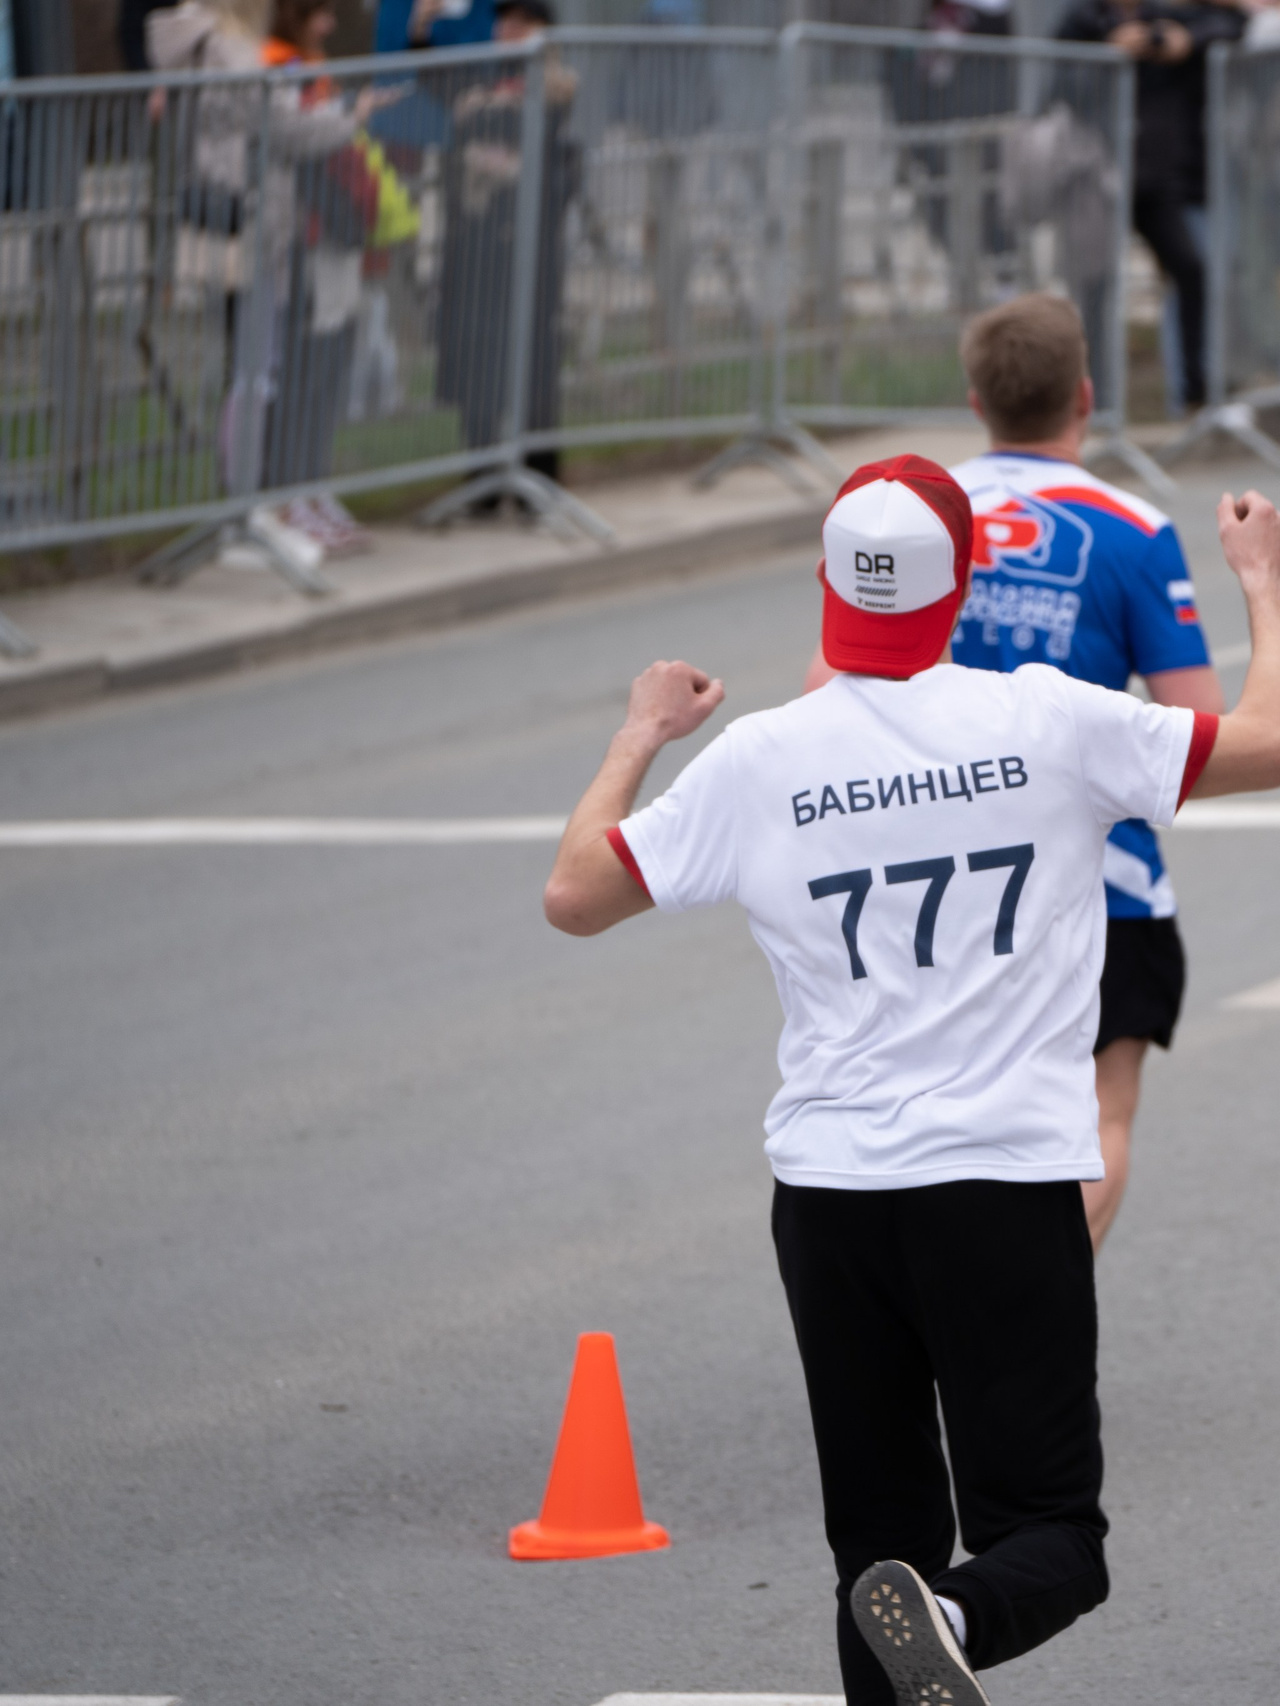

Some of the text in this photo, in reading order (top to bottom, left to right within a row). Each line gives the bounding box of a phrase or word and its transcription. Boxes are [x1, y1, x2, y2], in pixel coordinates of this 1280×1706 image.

[855, 551, 894, 575] DR
[791, 756, 1029, 827] БАБИНЦЕВ
[807, 842, 1035, 981] 777
